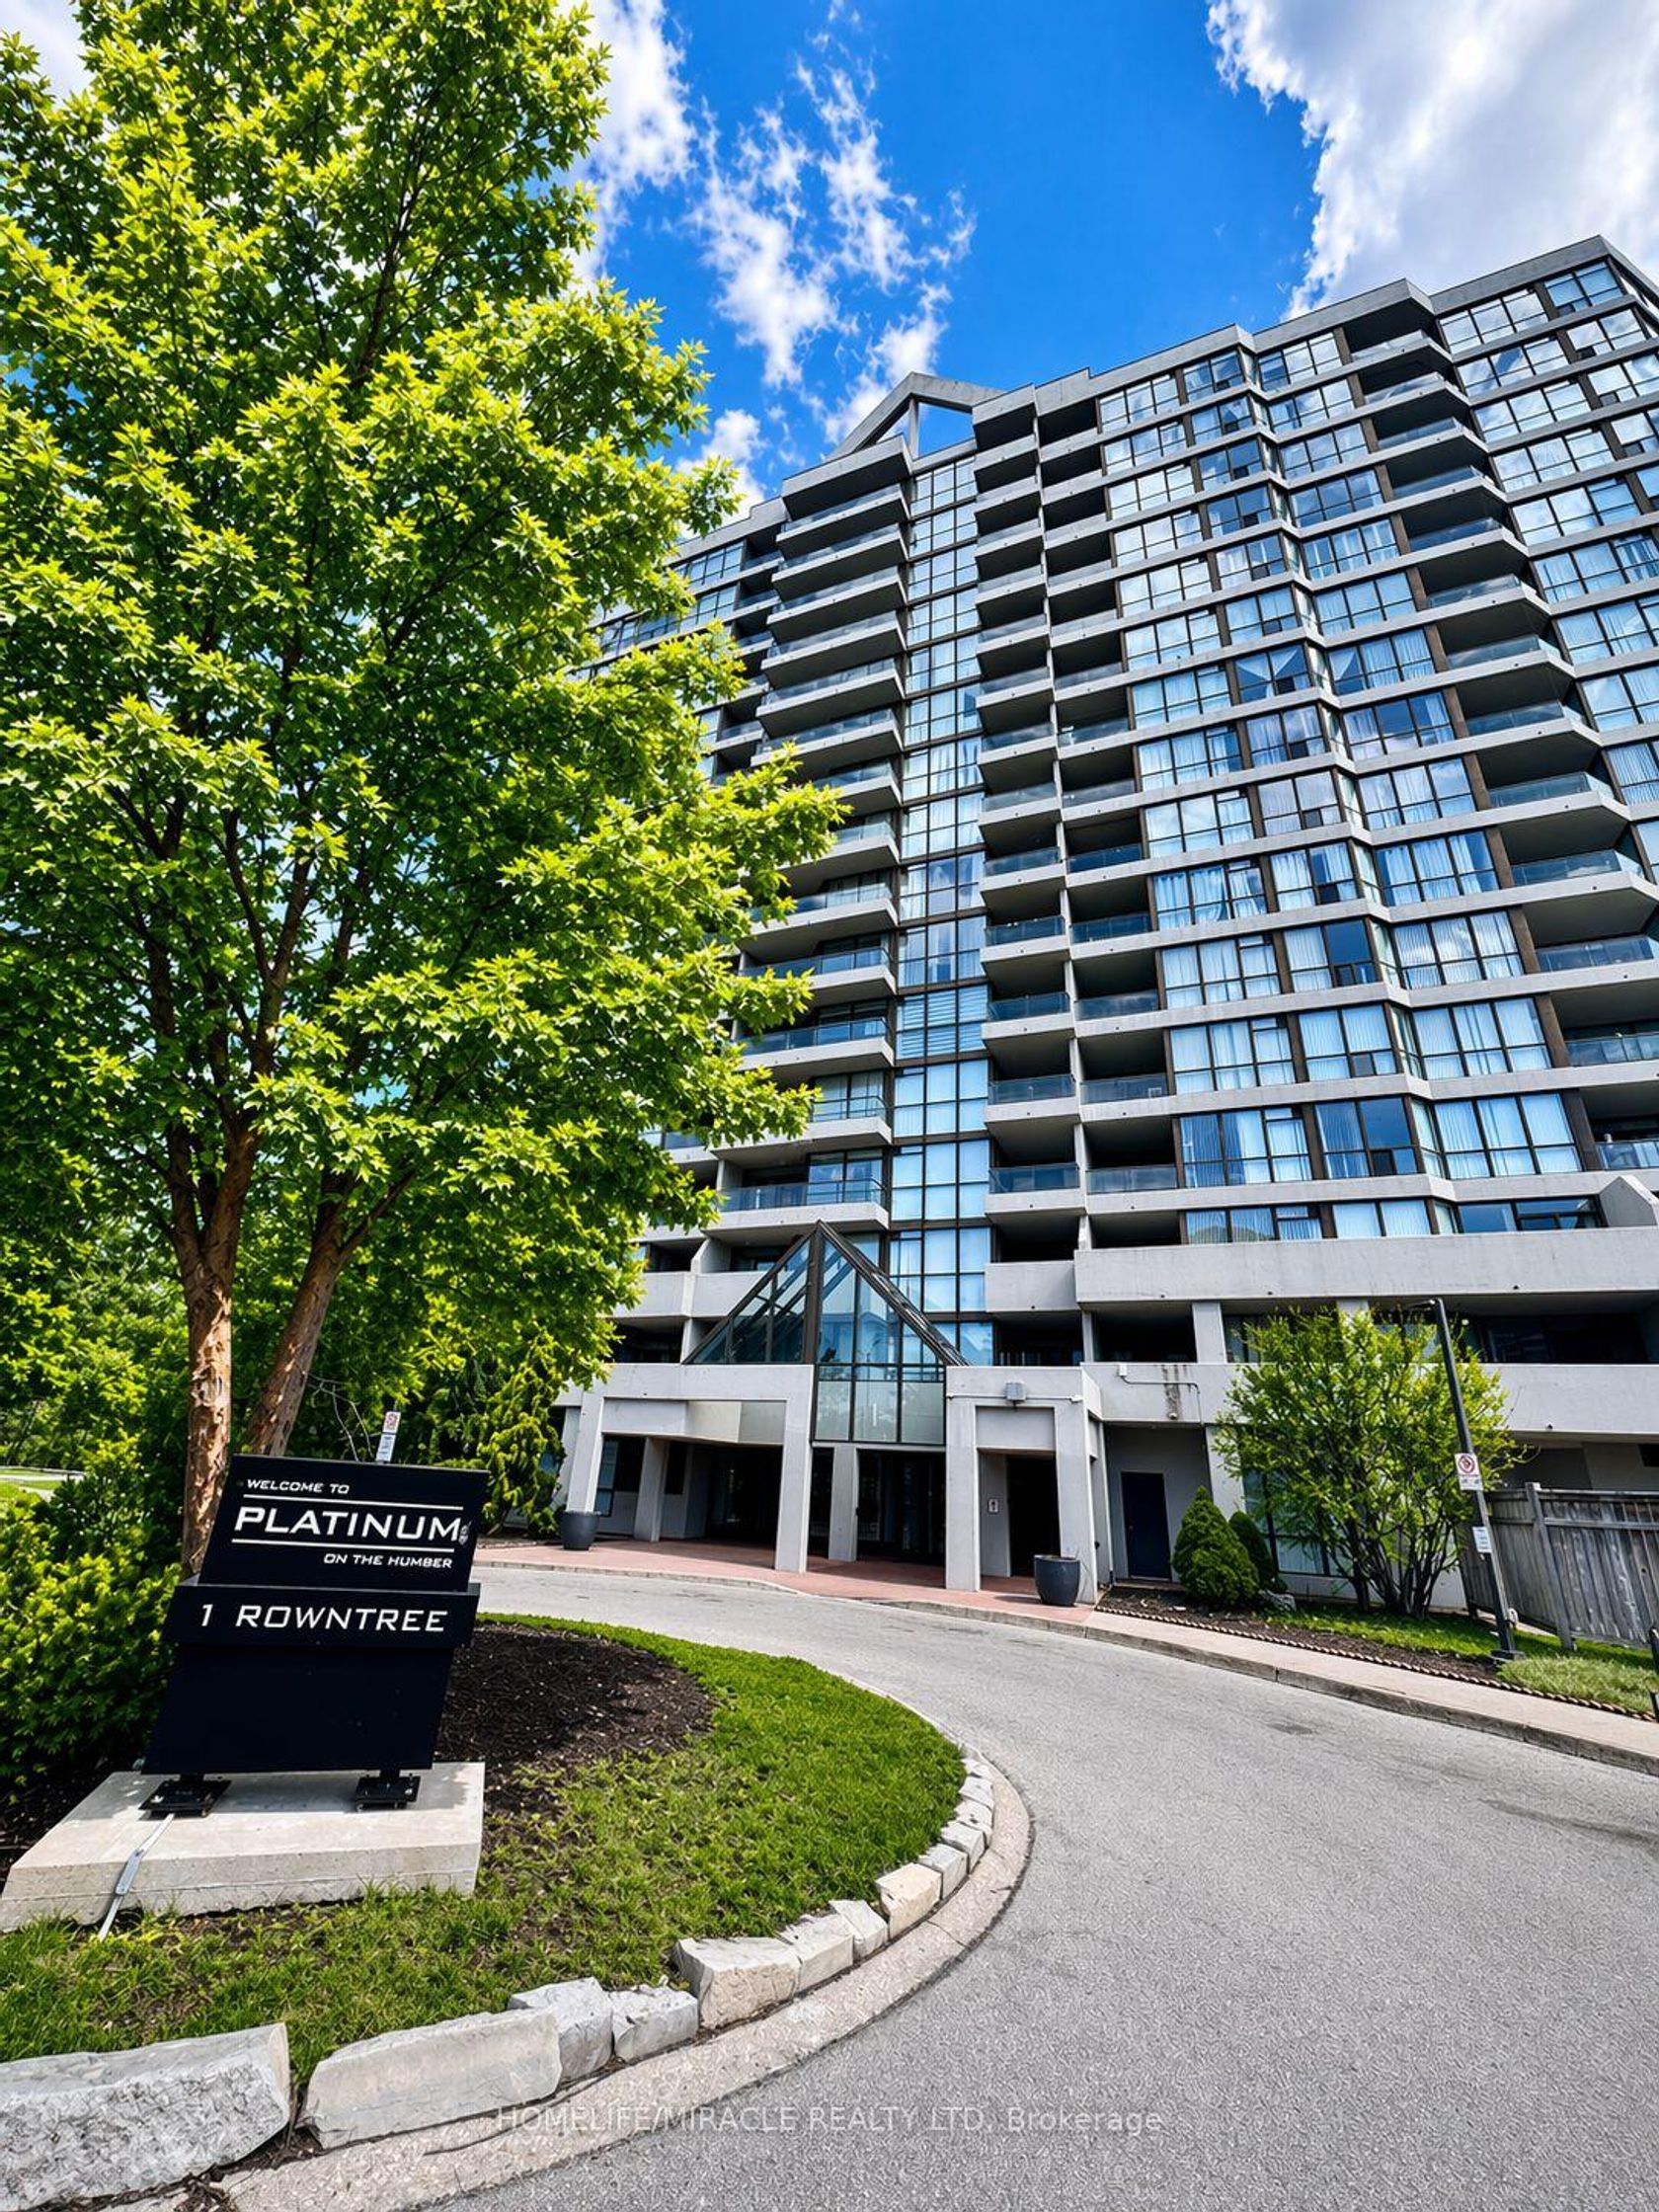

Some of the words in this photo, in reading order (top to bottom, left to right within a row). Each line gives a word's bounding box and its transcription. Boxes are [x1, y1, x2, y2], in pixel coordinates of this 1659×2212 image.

[247, 1479, 323, 1493] WELCOME
[329, 1484, 350, 1494] TO
[234, 1506, 461, 1541] PLATINUM
[324, 1553, 349, 1564] ON
[354, 1555, 383, 1566] THE
[387, 1556, 452, 1568] HUMBER
[200, 1604, 213, 1626] 1
[235, 1605, 448, 1632] ROWNTREE
